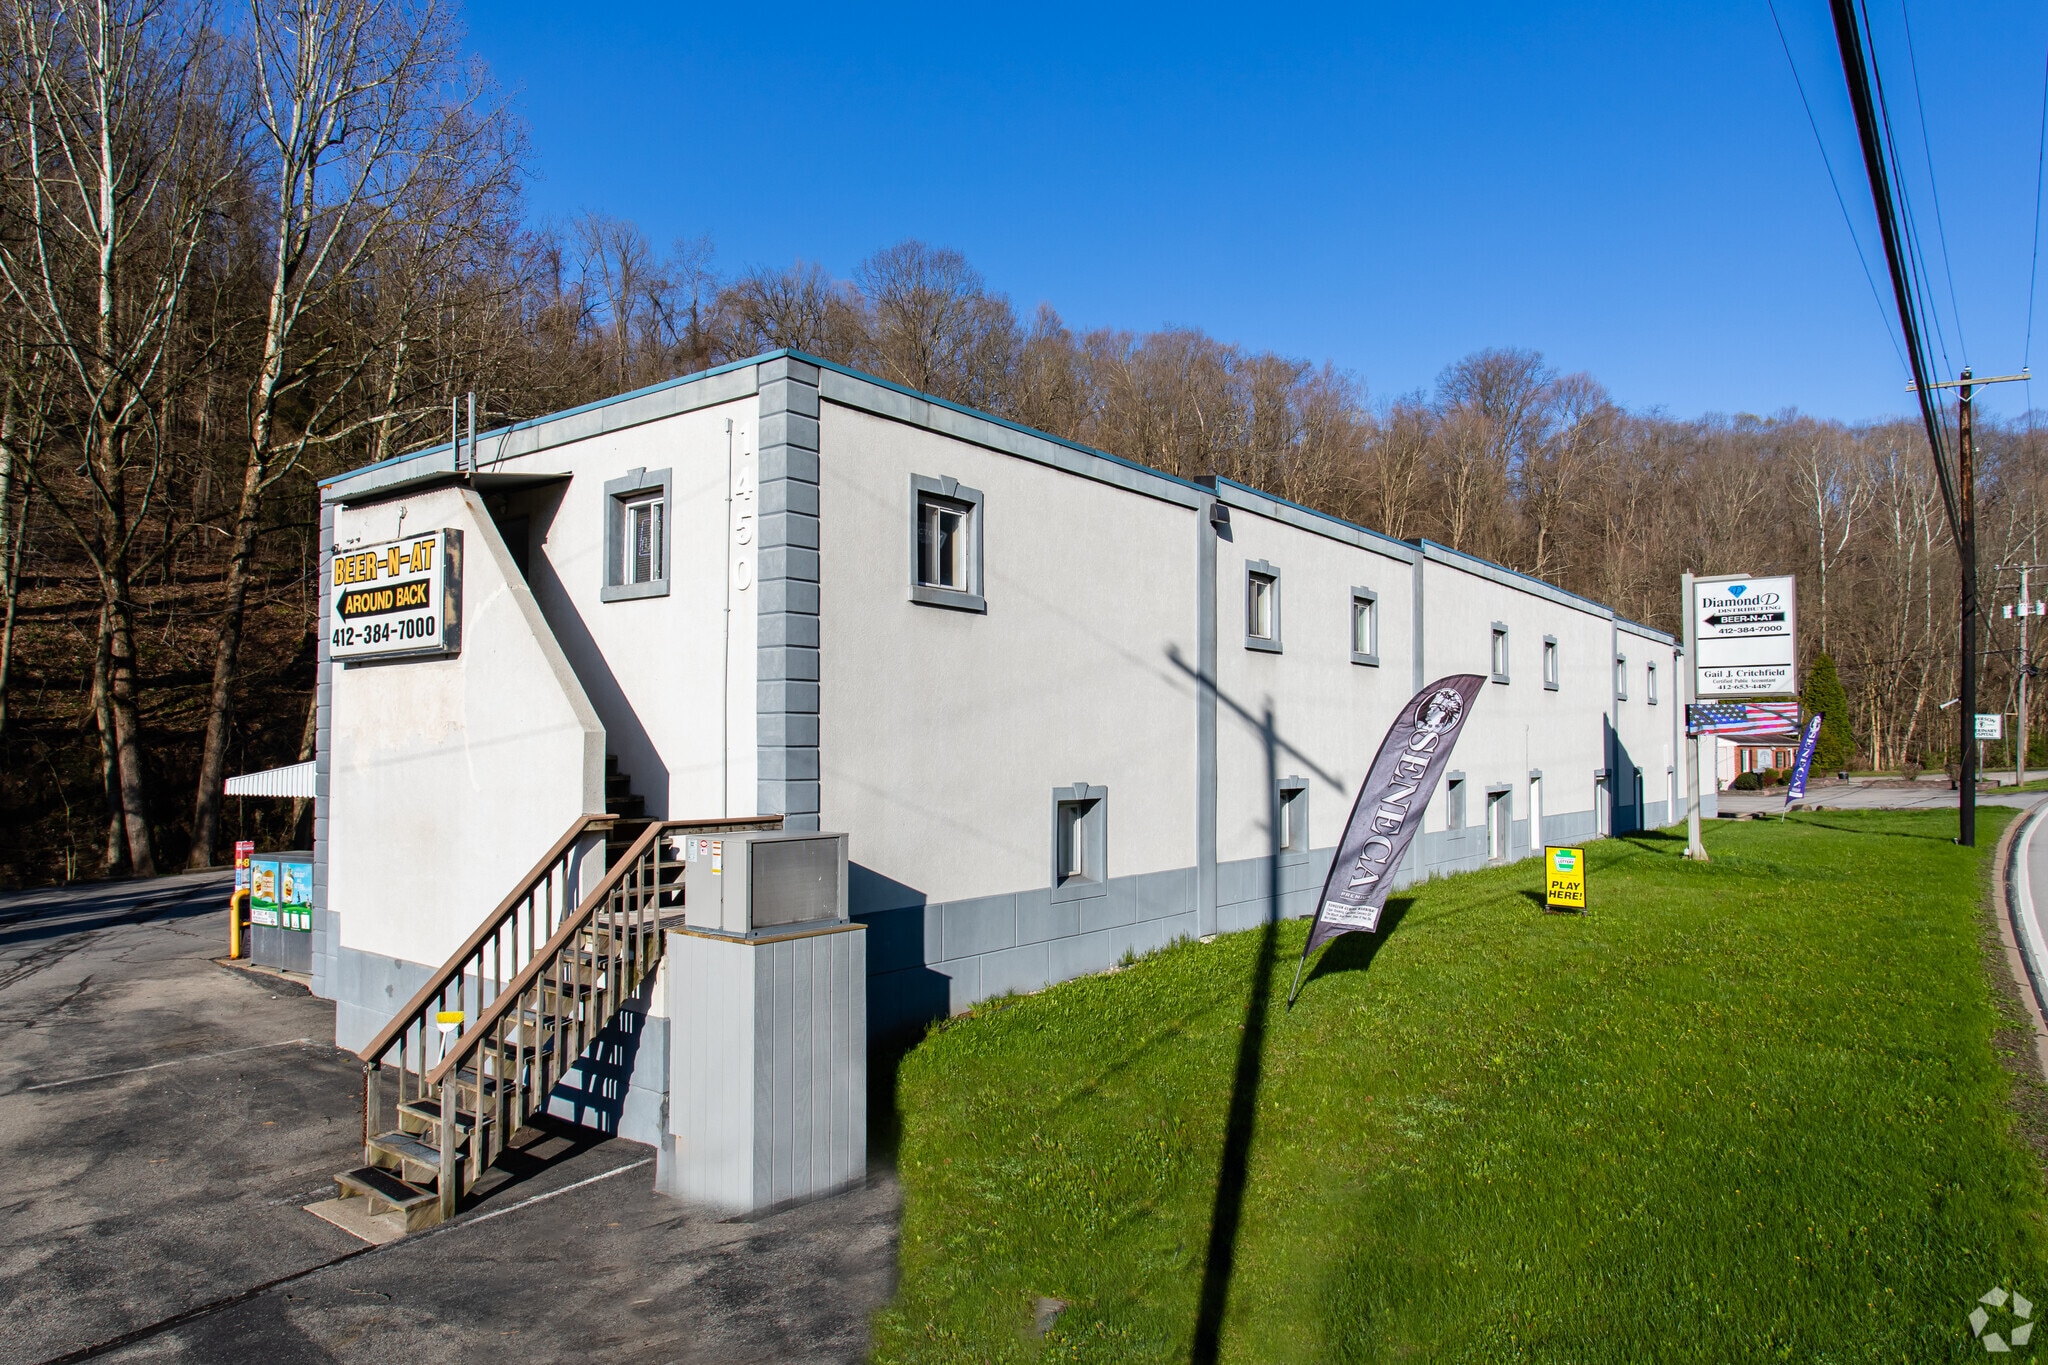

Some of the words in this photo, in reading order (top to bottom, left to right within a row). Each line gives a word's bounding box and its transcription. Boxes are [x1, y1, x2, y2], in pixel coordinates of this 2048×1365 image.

[334, 539, 435, 586] BEER-N-AT
[344, 590, 393, 615] AROUND
[395, 583, 427, 607] BACK
[1703, 595, 1760, 608] Diamond
[1718, 605, 1781, 613] DISTRIBUTING
[1721, 614, 1774, 624] BEER-N-AT
[332, 615, 436, 647] 412-384-7000
[1719, 625, 1782, 634] 412-384-7000
[1704, 670, 1723, 678] Gail
[1726, 670, 1733, 678] J.
[1736, 669, 1785, 677] Critchfield
[1793, 731, 1817, 788] SENECA
[1349, 729, 1440, 889] SENECA
[1551, 880, 1581, 890] PLAY
[1548, 890, 1583, 900] HERE!
